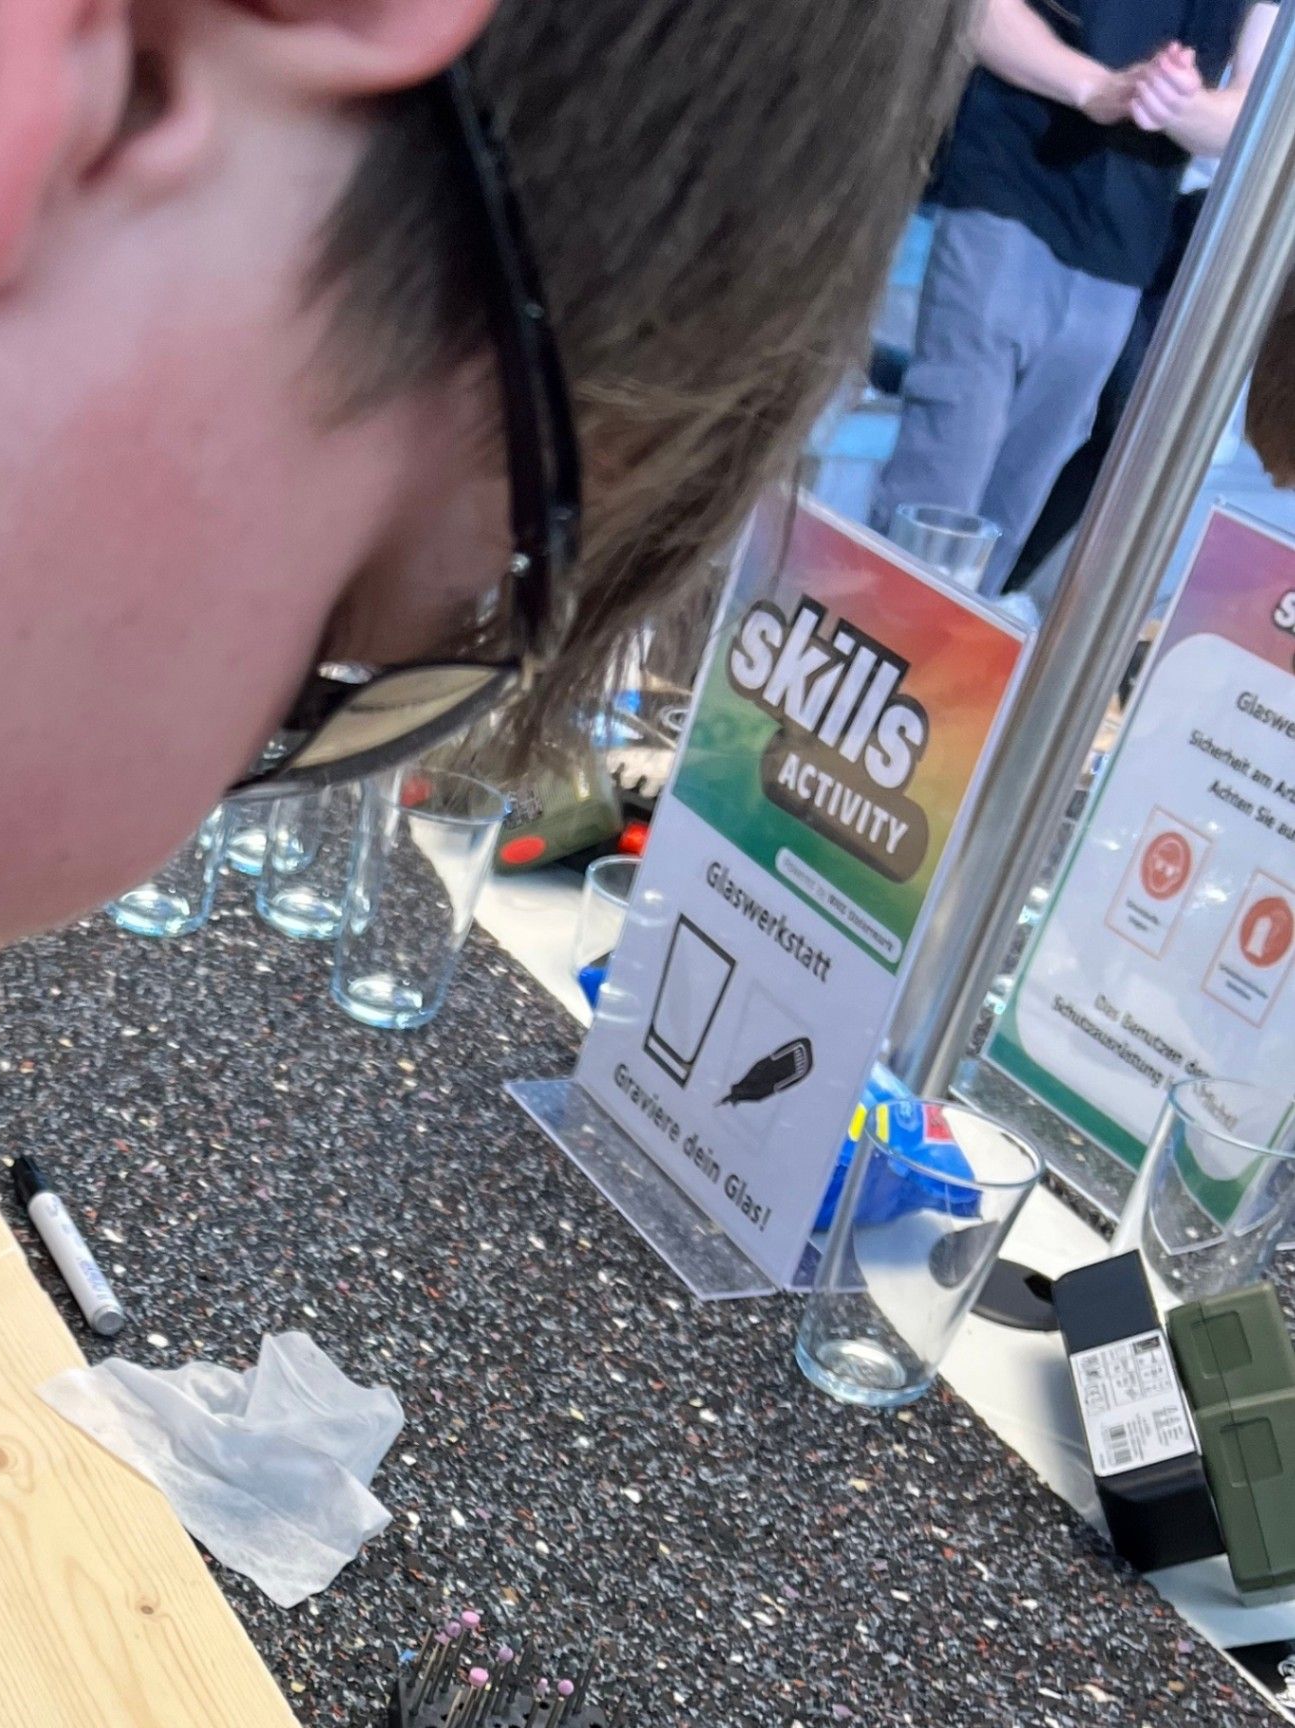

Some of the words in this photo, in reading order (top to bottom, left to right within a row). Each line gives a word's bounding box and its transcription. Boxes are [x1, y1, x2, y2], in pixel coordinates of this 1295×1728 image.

[730, 606, 924, 789] skills
[778, 752, 909, 854] ACTIVITY
[1189, 729, 1251, 776] Sicherheit
[1251, 769, 1273, 789] am
[1208, 779, 1254, 817] Achten
[1254, 805, 1275, 829] Sie
[706, 861, 832, 983] Glaswerkstatt
[613, 1063, 681, 1143] Graviere
[682, 1132, 722, 1185] dein
[723, 1173, 772, 1232] Glas!
